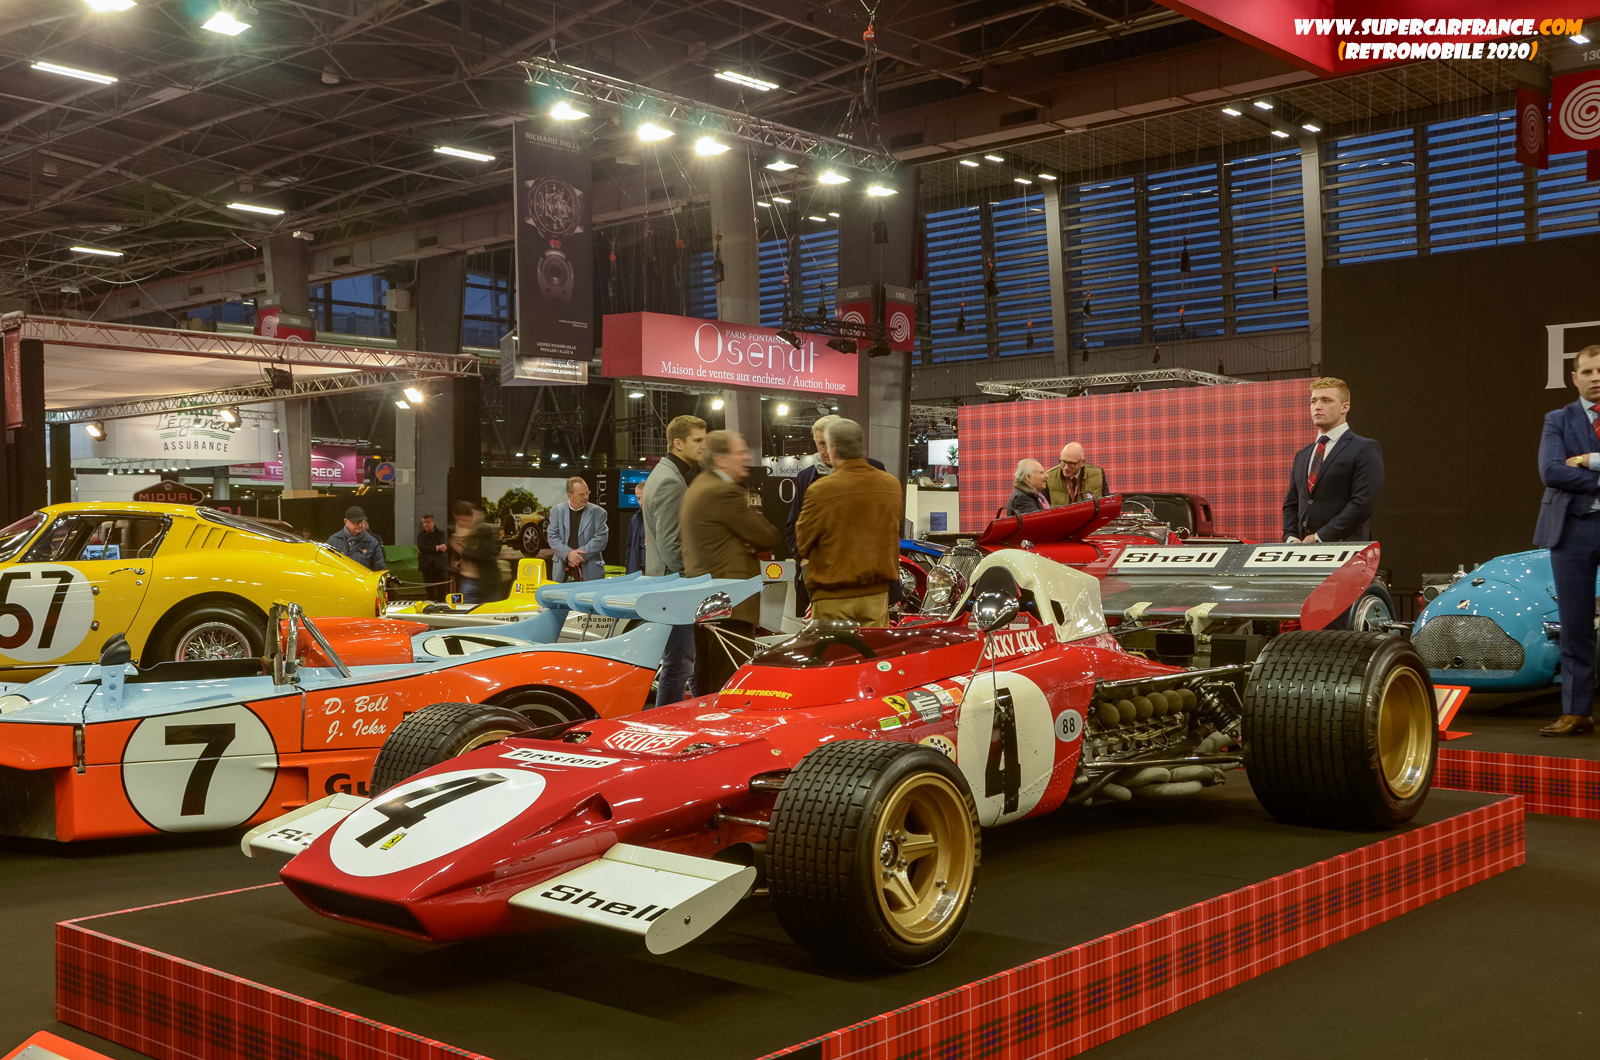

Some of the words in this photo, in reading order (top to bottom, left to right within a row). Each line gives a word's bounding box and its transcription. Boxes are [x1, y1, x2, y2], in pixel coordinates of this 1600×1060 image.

[525, 132, 558, 145] RICHARD
[559, 139, 581, 150] MILLE
[725, 330, 746, 339] PARIS
[695, 323, 819, 373] Osenat
[661, 361, 694, 375] Maison
[697, 367, 707, 377] de
[709, 370, 735, 381] ventes
[736, 372, 750, 382] aux
[752, 373, 786, 386] enchères
[793, 375, 824, 389] Auction
[825, 382, 846, 391] house
[163, 441, 229, 453] ASSURANCE
[139, 493, 199, 502] MIDUAL
[1122, 552, 1219, 563] Shell
[0, 571, 75, 650] 57
[1016, 630, 1044, 654] ICKX
[744, 689, 793, 700] MOTORSPORT
[324, 697, 345, 715] D.
[354, 695, 389, 713] Bell
[352, 718, 387, 737] Ickx
[1063, 717, 1075, 735] 88
[510, 750, 610, 766] Firestone
[985, 687, 1022, 817] 4
[165, 723, 236, 817] 7
[355, 772, 510, 849] 4
[540, 884, 670, 923] Shell
